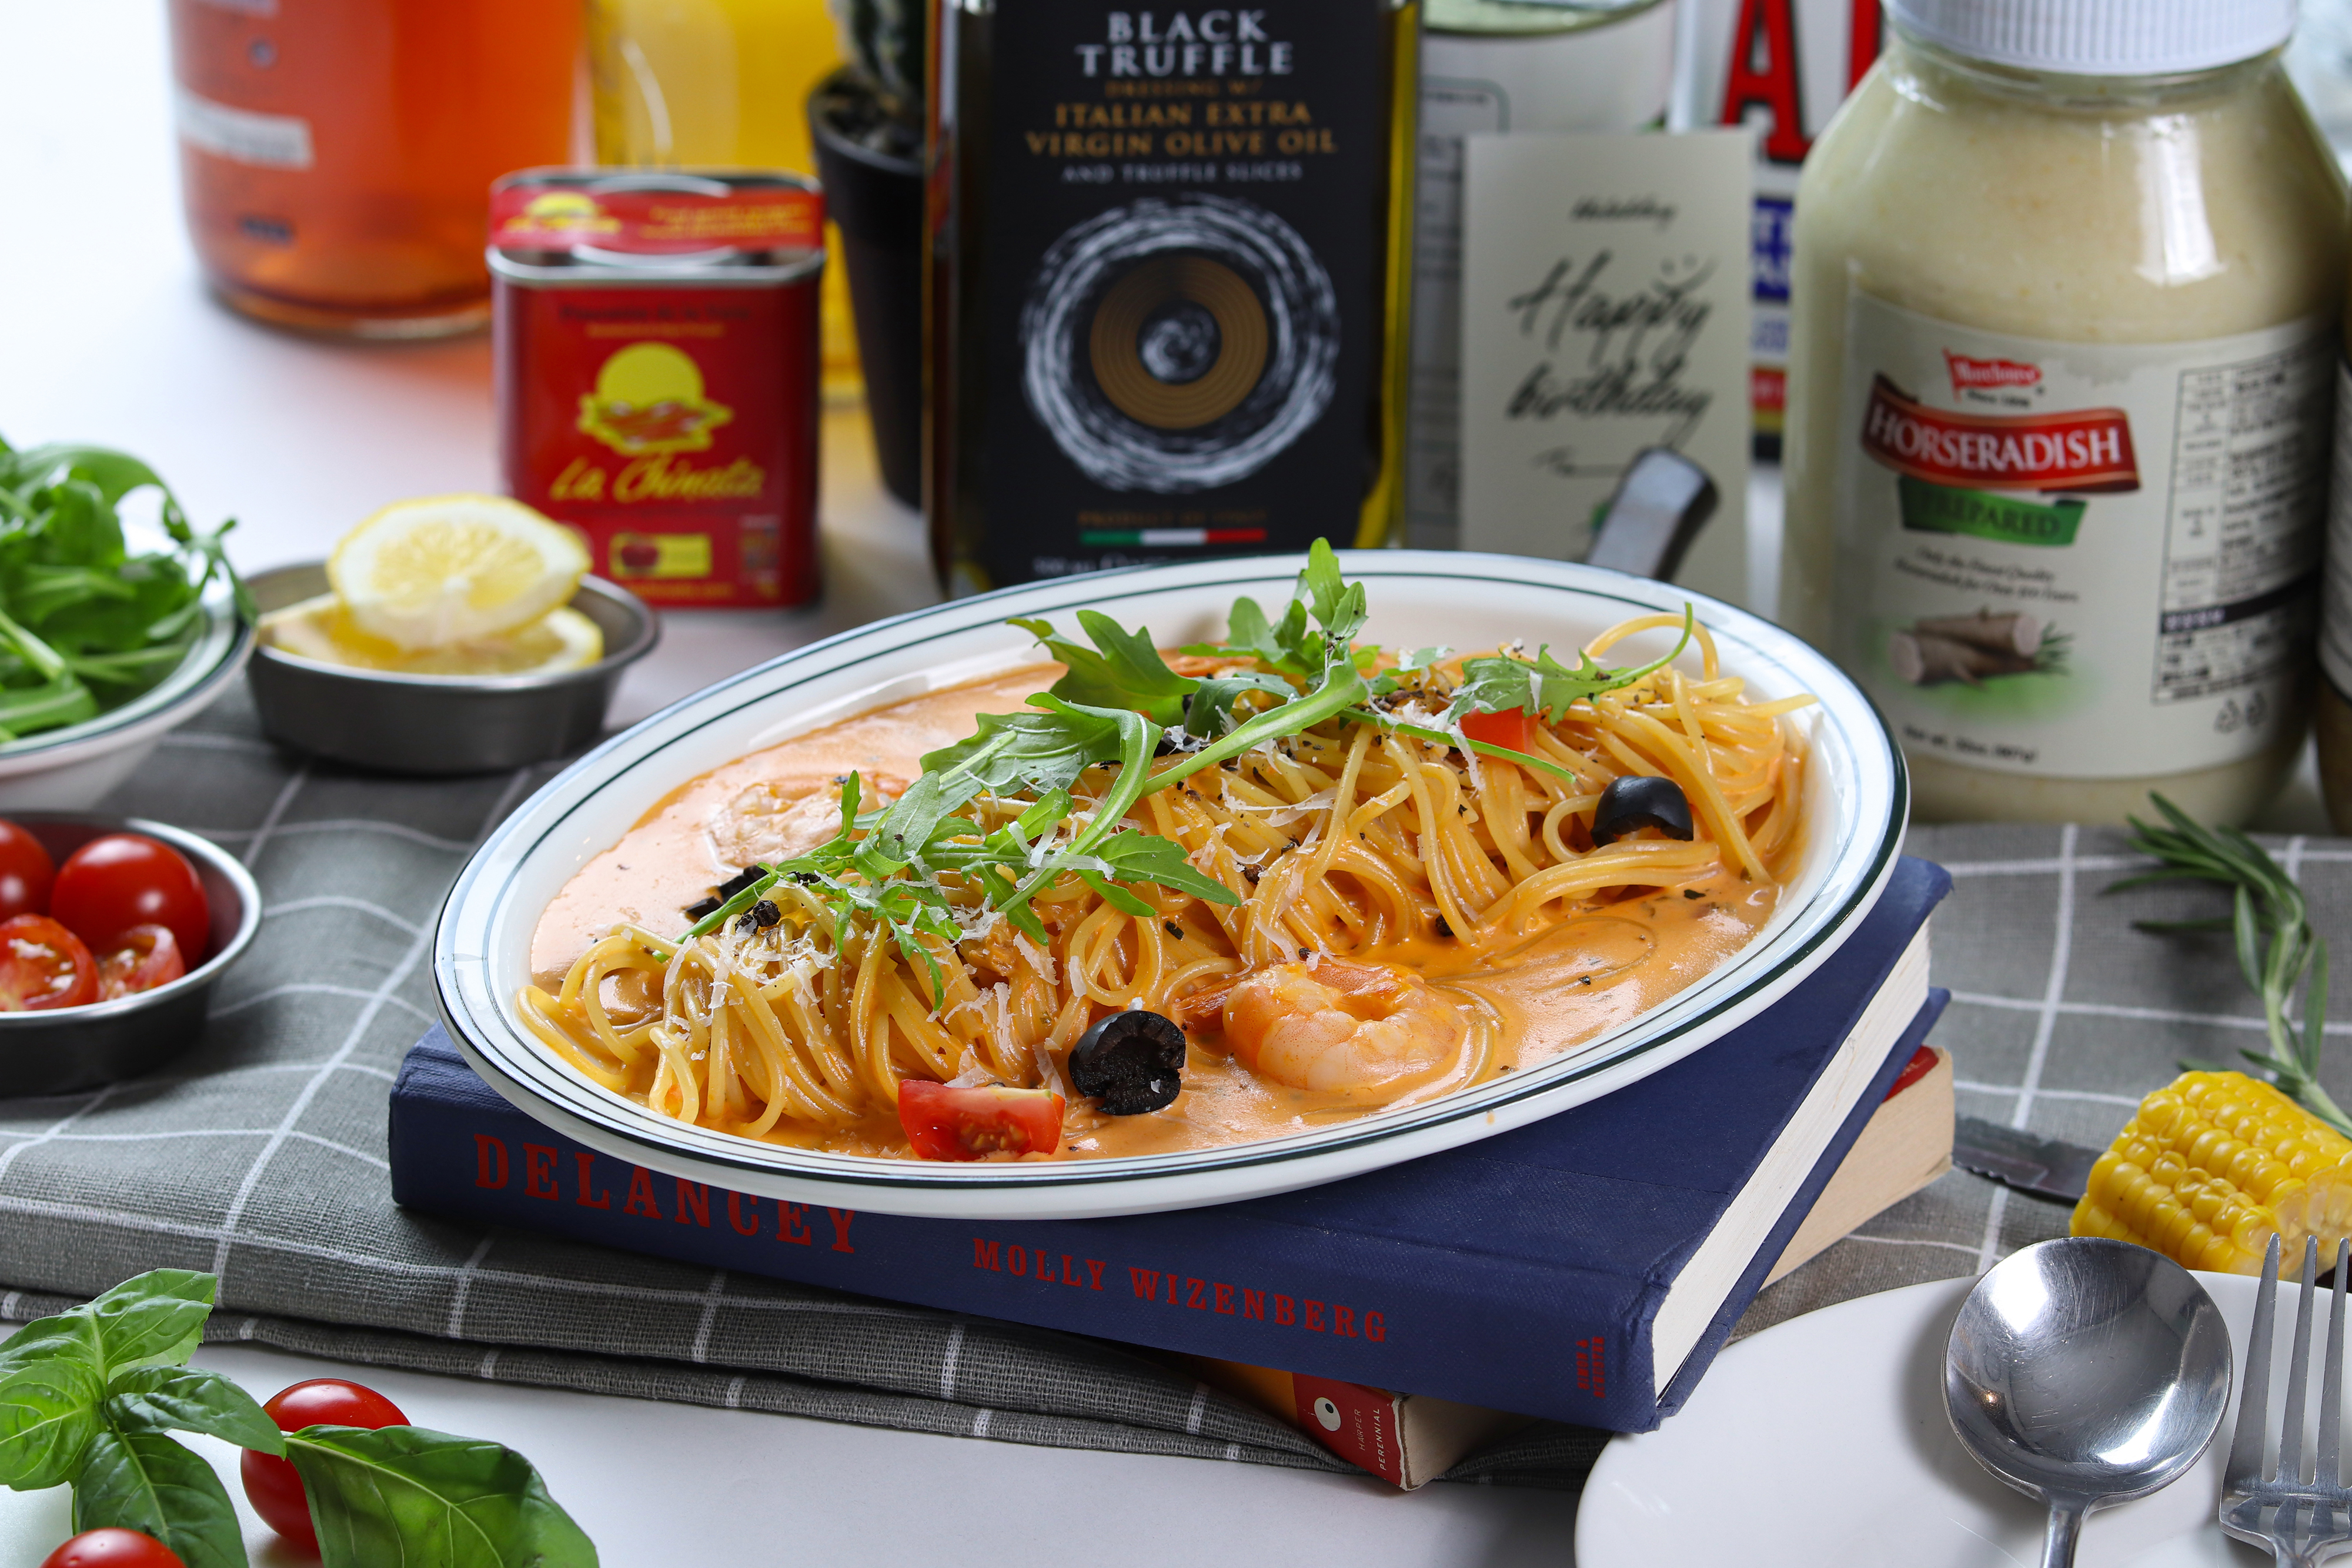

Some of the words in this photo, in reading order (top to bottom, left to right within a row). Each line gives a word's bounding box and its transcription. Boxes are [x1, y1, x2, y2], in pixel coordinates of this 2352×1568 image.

[1107, 11, 1269, 43] BLACK
[1076, 42, 1293, 76] TRUFFLE
[1056, 102, 1192, 128] ITALIAN
[1207, 101, 1312, 126] EXTRA
[1025, 130, 1153, 157] VIRGIN
[1164, 129, 1265, 156] OLIVE
[1277, 128, 1338, 155] OIL
[1061, 163, 1116, 185] AND
[1121, 162, 1217, 183] TRUFFLE
[1225, 160, 1304, 182] SLICES
[1507, 249, 1713, 367] Happy
[1867, 402, 2122, 472] HORSERADISH
[549, 455, 606, 502] La
[1919, 487, 2062, 539] PREPARED
[473, 1133, 856, 1254] DELANCEY
[972, 1237, 1107, 1291] MOLLY
[1129, 1266, 1388, 1344] WIZENBERG
[1373, 1407, 1387, 1471] PERENNIAL
